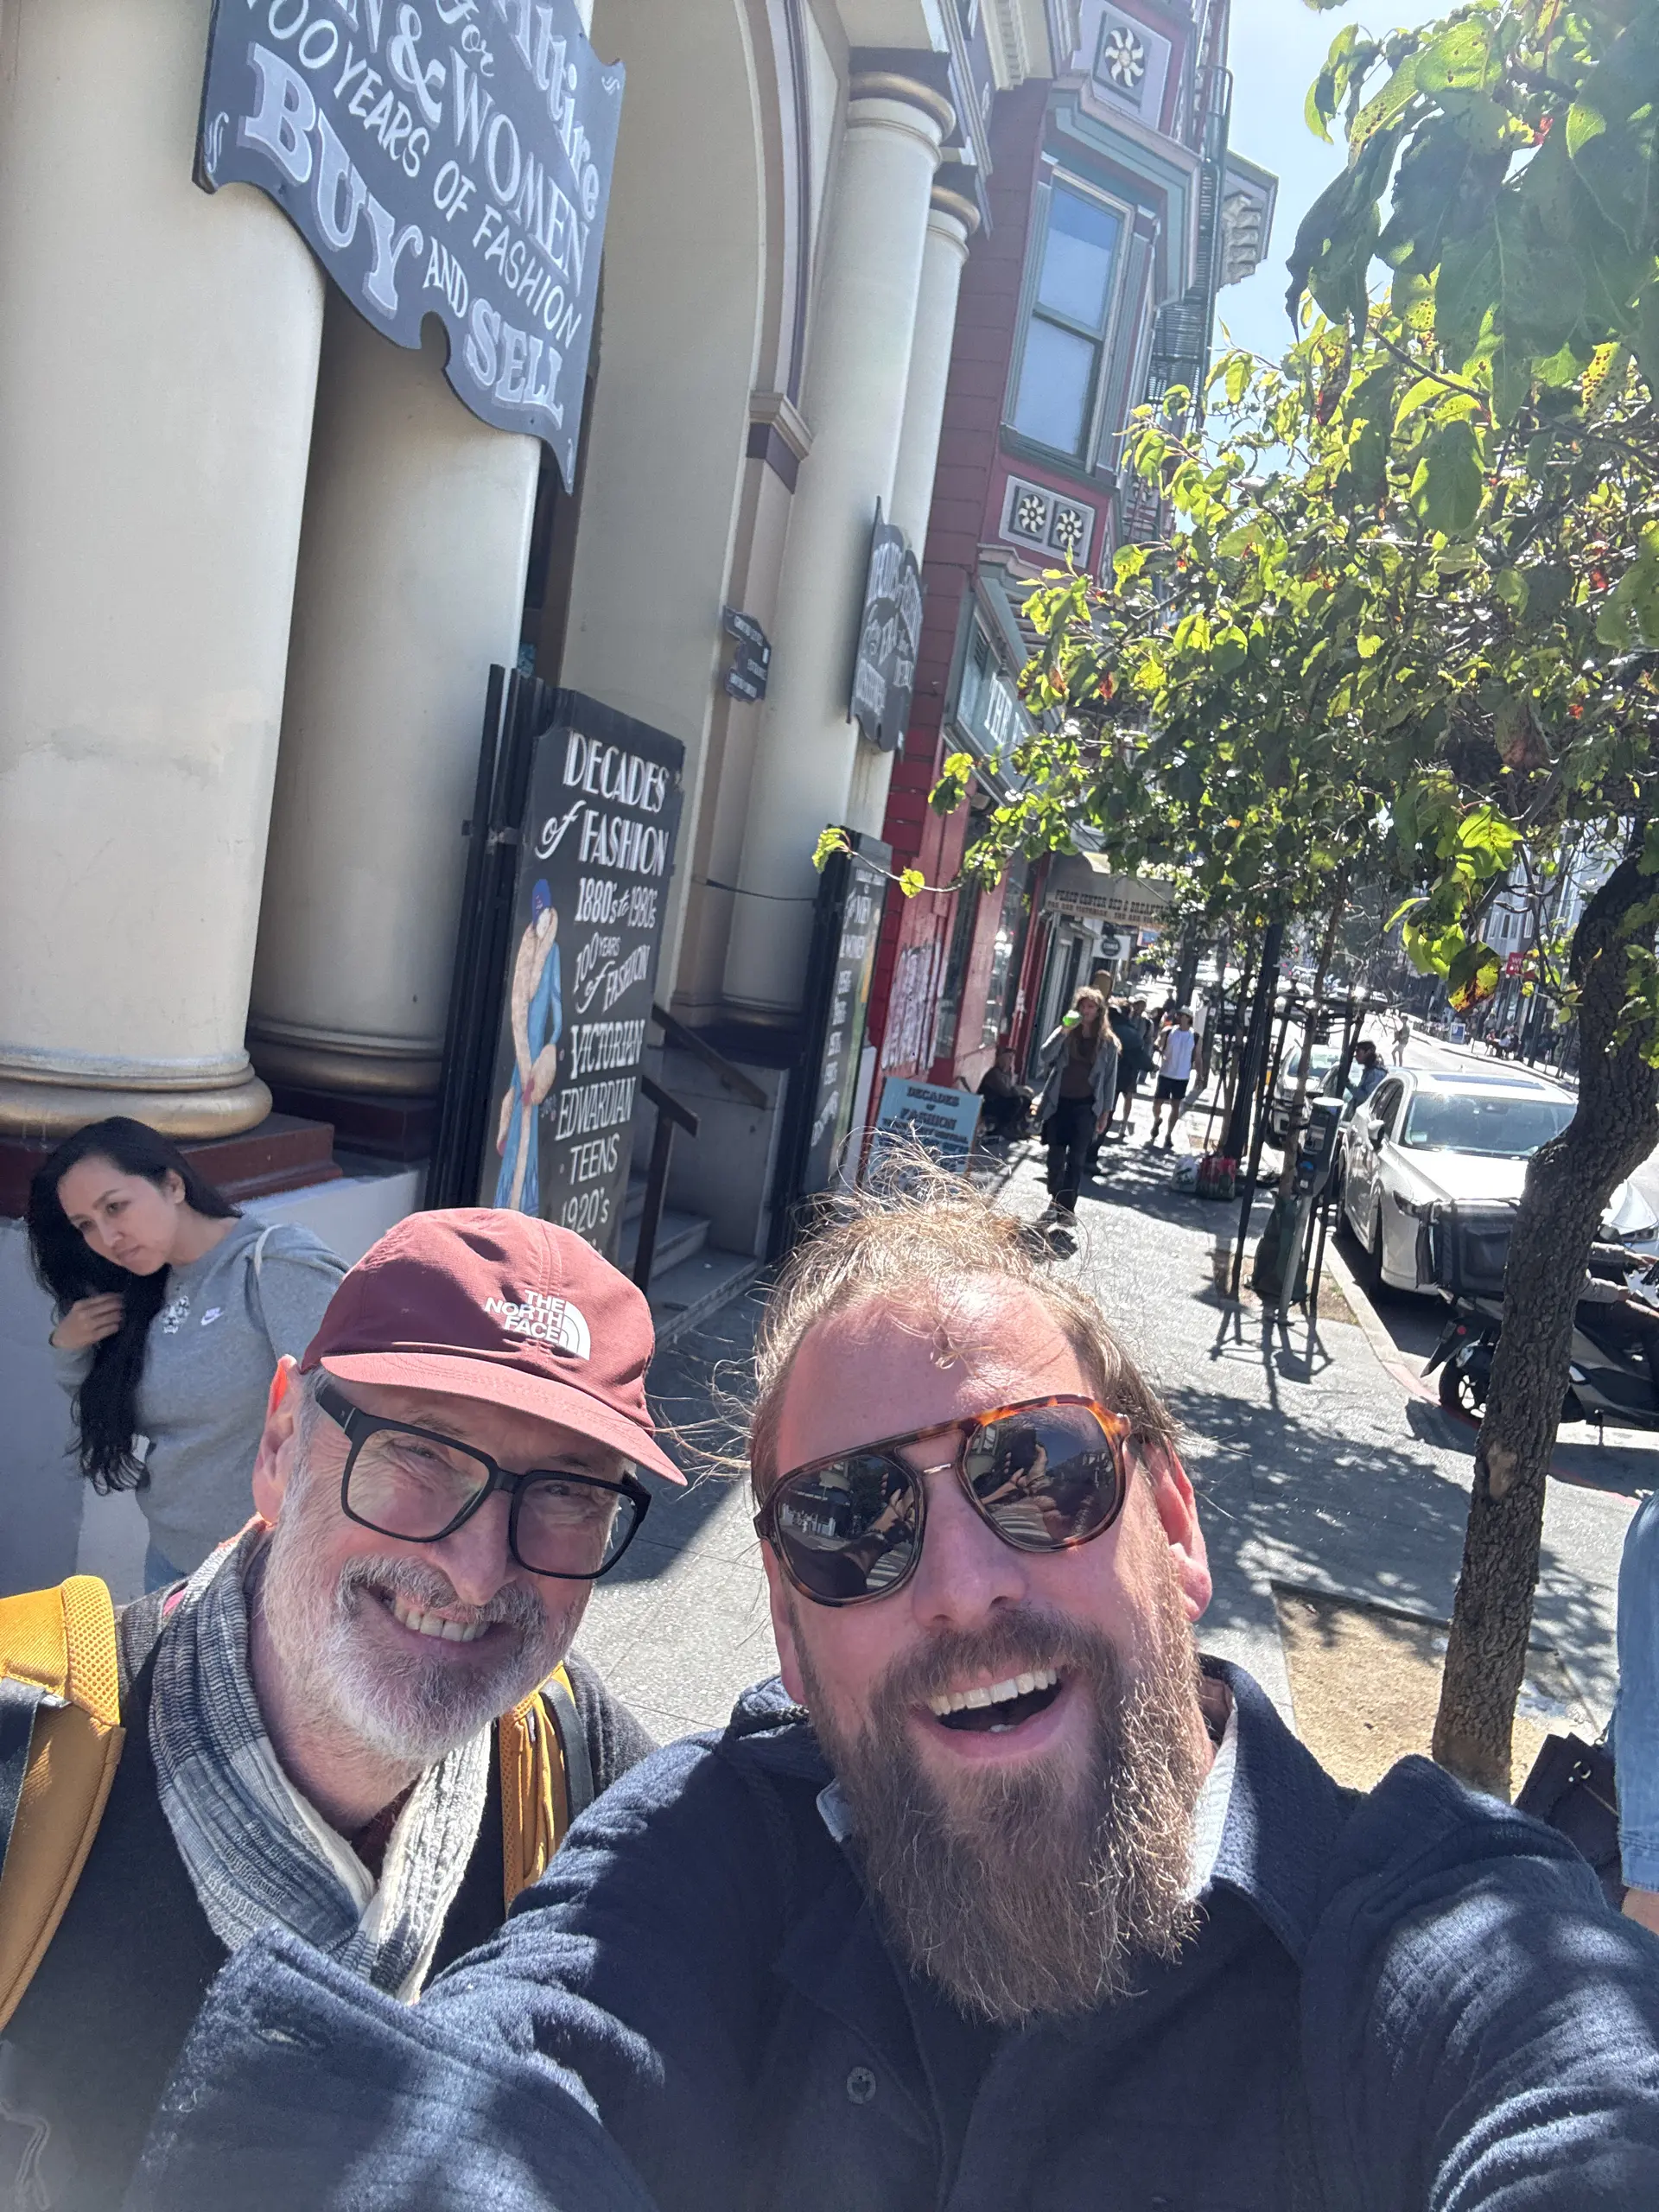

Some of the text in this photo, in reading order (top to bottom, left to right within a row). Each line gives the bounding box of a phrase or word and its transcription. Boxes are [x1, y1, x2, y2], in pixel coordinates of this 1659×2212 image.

[248, 0, 339, 69] 00
[334, 41, 429, 177] YEARS
[434, 160, 477, 221] OF
[473, 204, 582, 348] FASHION
[448, 46, 590, 296] WOMEN
[236, 41, 564, 430] BUY AND SELL
[563, 730, 670, 813] DECADES
[535, 800, 670, 877] of FASHION
[574, 878, 618, 925] 1880's
[572, 932, 621, 996] 100 YEARS
[575, 944, 651, 1014] of FASHION
[570, 1020, 645, 1080] VICTORIAN
[555, 1077, 637, 1141] EDWARDIAN
[899, 1108, 957, 1130] FASHION
[906, 1087, 960, 1107] DECADES
[570, 1132, 620, 1185] TEENS
[563, 1187, 610, 1234] 1920's
[483, 1297, 563, 1329] NORTH
[504, 1316, 561, 1344] FACE
[524, 1289, 565, 1313] THE
